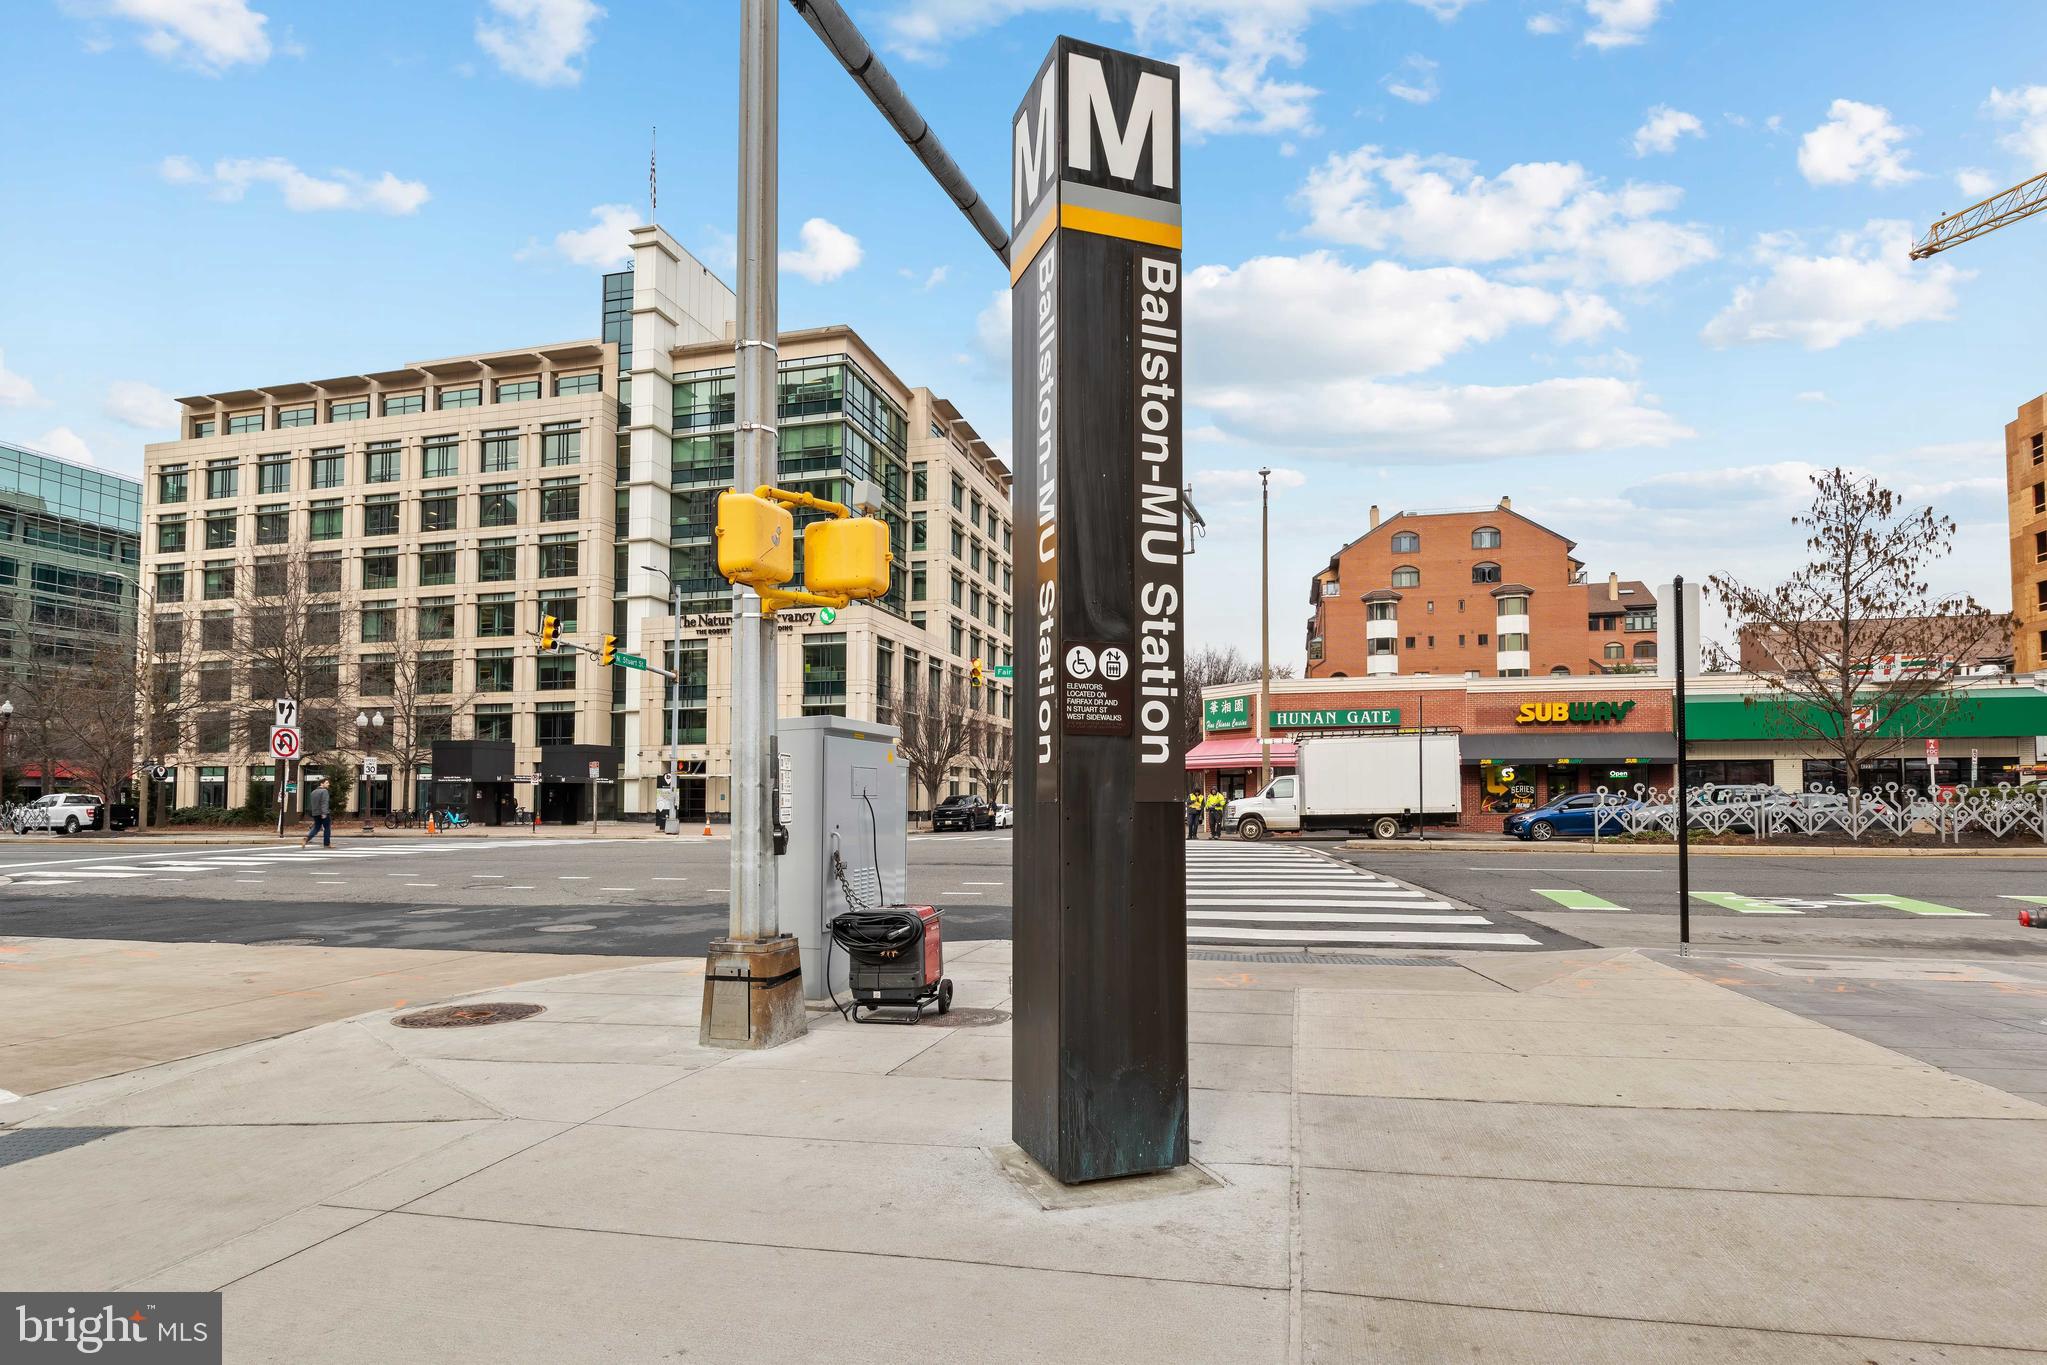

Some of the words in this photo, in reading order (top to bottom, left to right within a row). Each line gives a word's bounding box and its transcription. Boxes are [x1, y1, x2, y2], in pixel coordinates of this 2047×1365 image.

[1068, 52, 1173, 189] M
[1014, 59, 1055, 229] M
[1039, 246, 1055, 564] Ballston-MU
[1141, 256, 1178, 564] Ballston-MU
[680, 615, 696, 628] The
[698, 614, 733, 627] Natur
[1038, 579, 1056, 763] Station
[1141, 582, 1178, 763] Station
[1066, 682, 1103, 690] ELEVATORS
[1073, 705, 1098, 713] STUART
[1086, 713, 1122, 721] SIDEWALKS
[1277, 711, 1337, 725] HUNAN
[1347, 710, 1392, 724] GATE
[1515, 700, 1637, 723] SUBWAY
[365, 765, 376, 773] 30
[1511, 785, 1535, 794] SERIES
